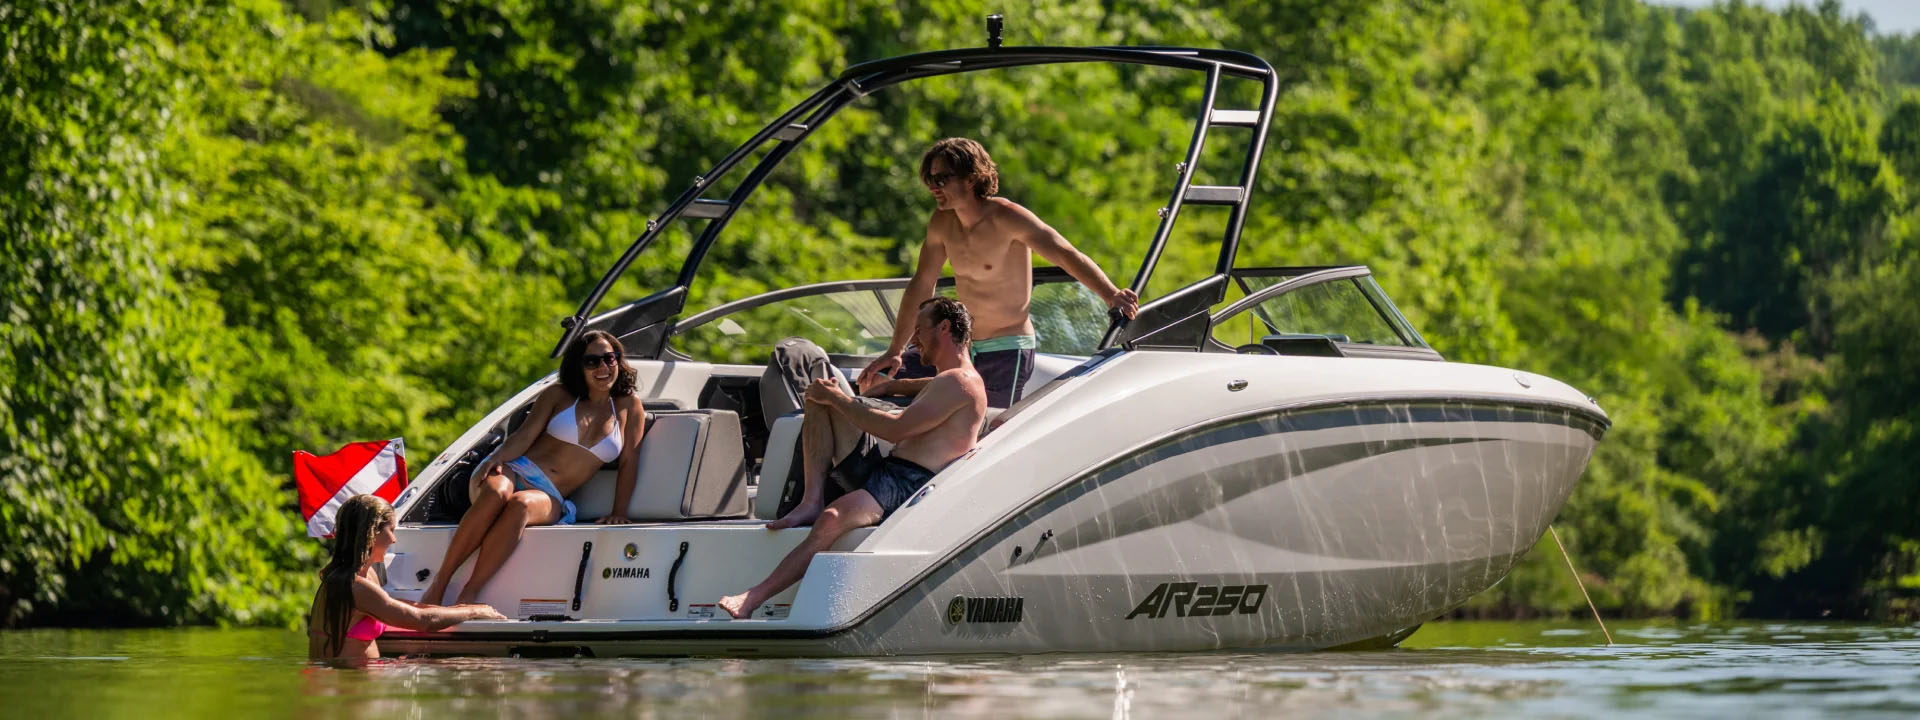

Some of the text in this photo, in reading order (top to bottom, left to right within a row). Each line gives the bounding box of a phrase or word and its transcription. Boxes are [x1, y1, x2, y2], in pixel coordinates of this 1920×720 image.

[612, 567, 650, 579] YAMAHA
[966, 597, 1024, 623] YAMAHA
[1125, 582, 1269, 620] AR250
